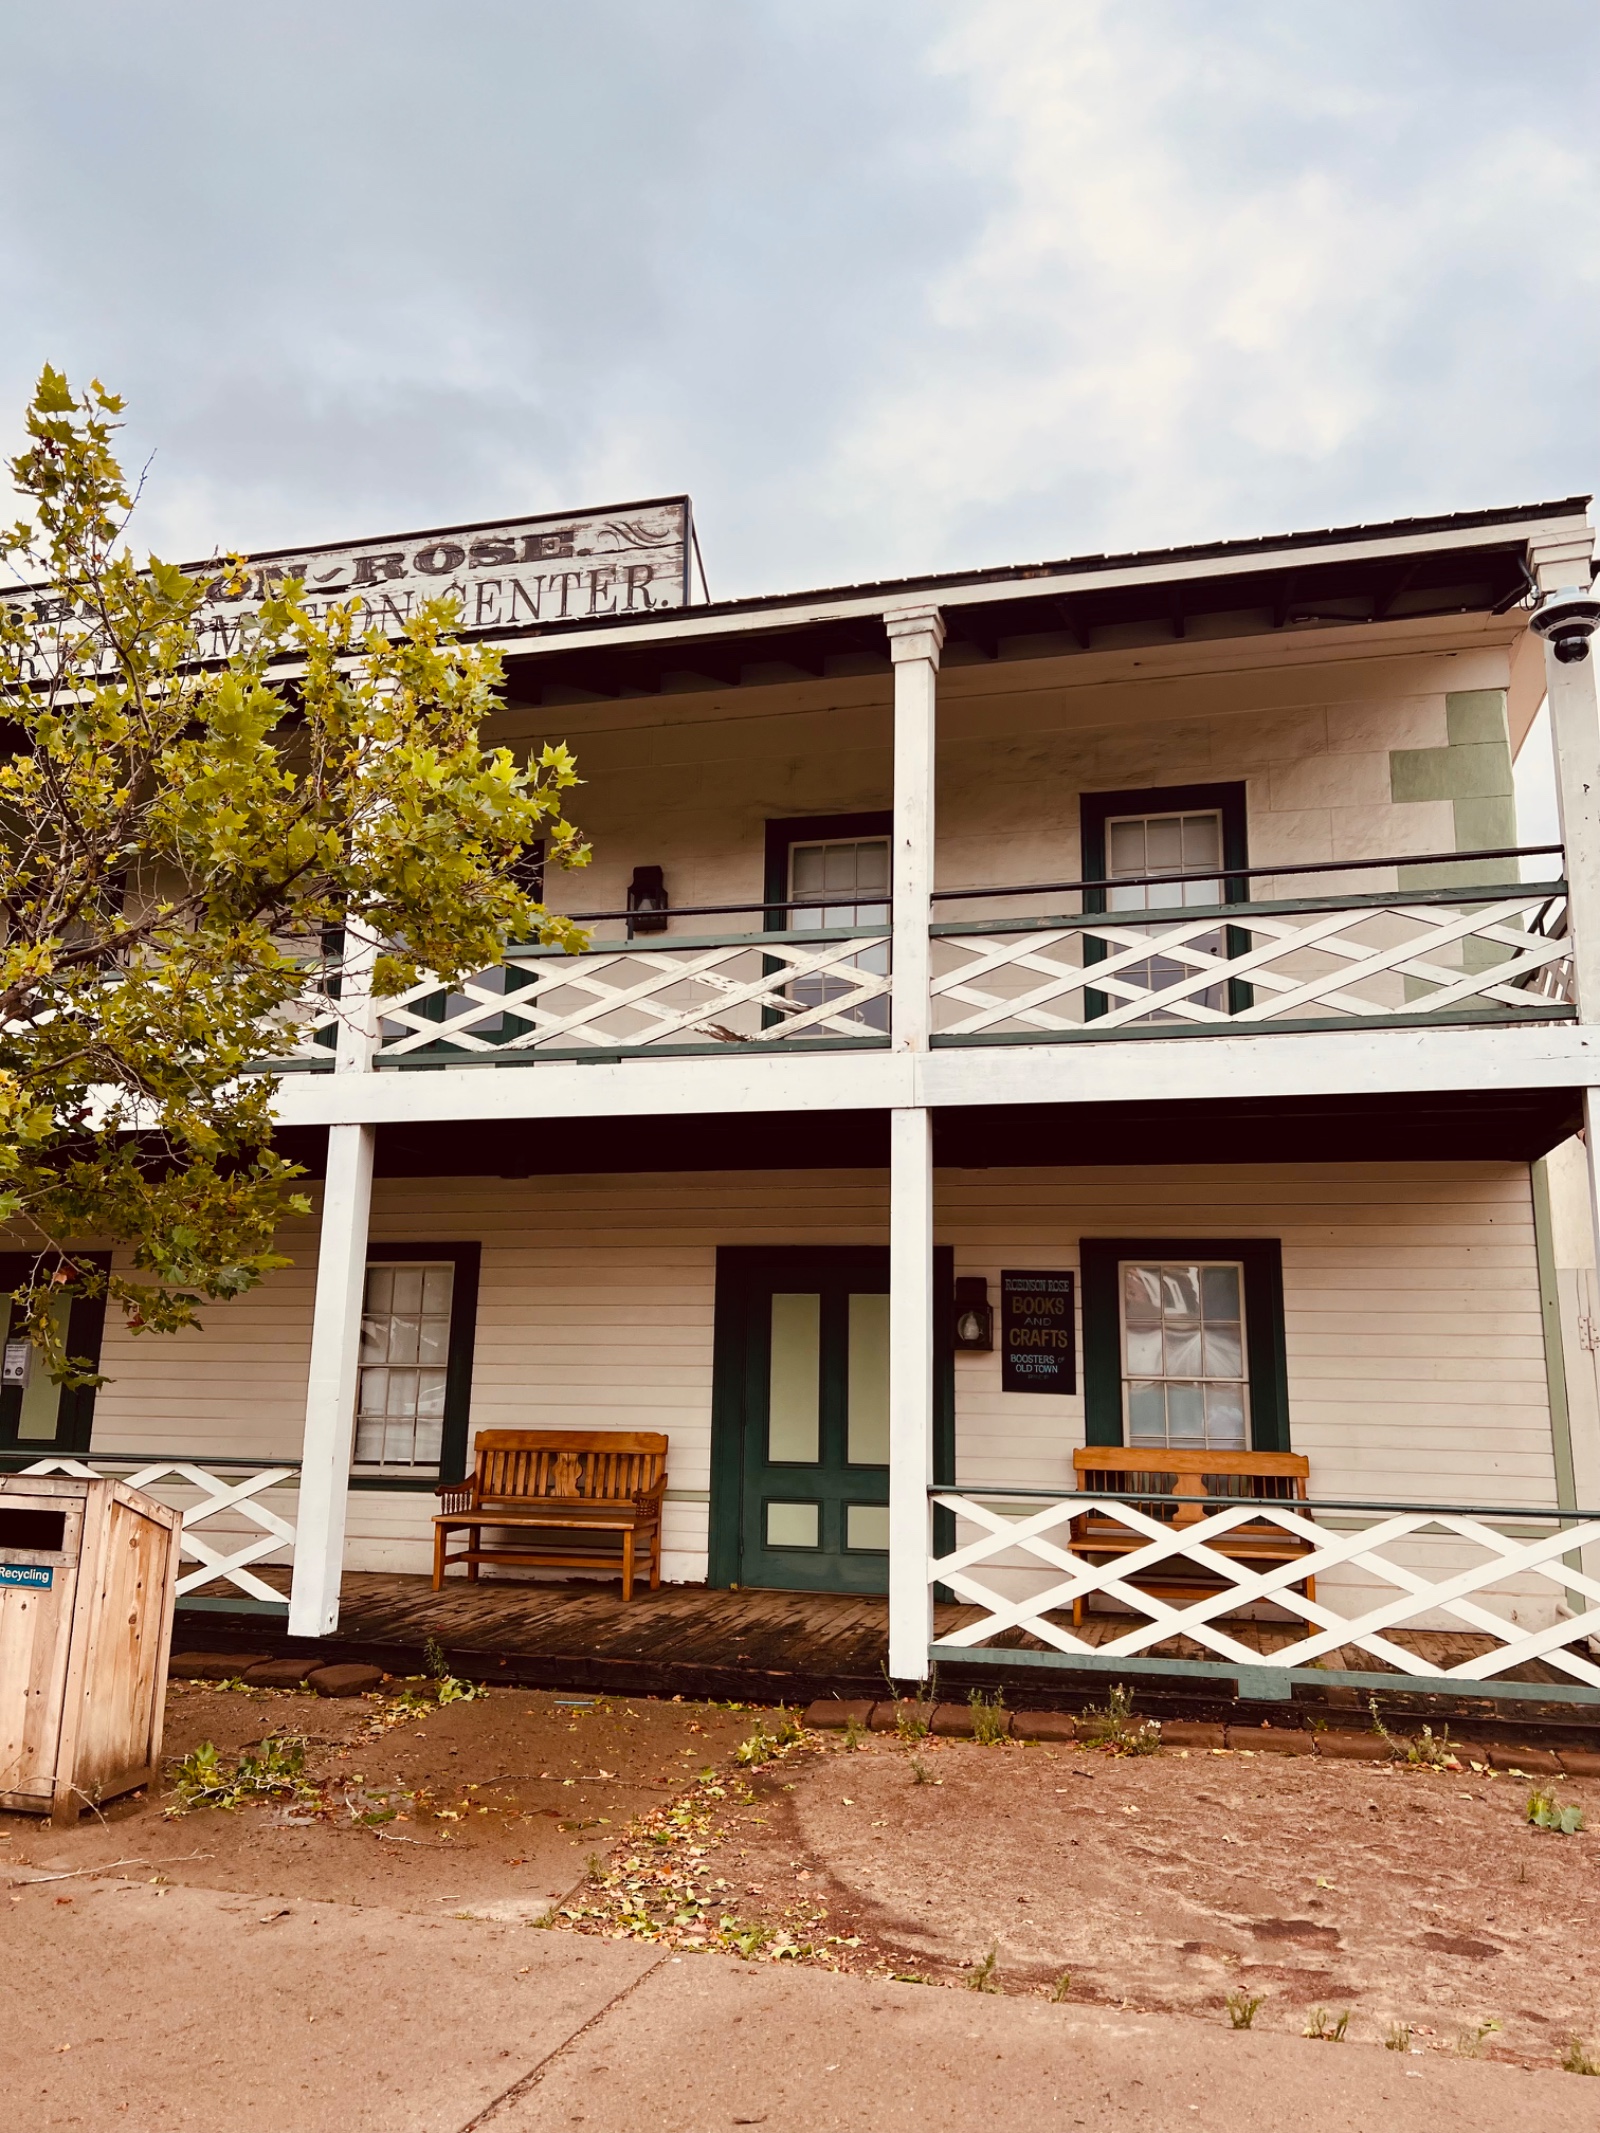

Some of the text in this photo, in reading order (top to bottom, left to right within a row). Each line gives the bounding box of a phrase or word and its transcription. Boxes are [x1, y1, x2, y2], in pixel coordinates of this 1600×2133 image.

[351, 529, 592, 584] ROSE.
[441, 563, 669, 628] CENTER.
[1005, 1279, 1070, 1293] ROBINSON ROSE
[1012, 1296, 1065, 1315] BOOKS
[1024, 1317, 1052, 1327] AND
[1009, 1328, 1068, 1349] CRAFTS
[1010, 1353, 1055, 1364] BOOSTERS
[1015, 1364, 1058, 1374] OLD TOWN
[0, 1566, 50, 1584] Recycling
